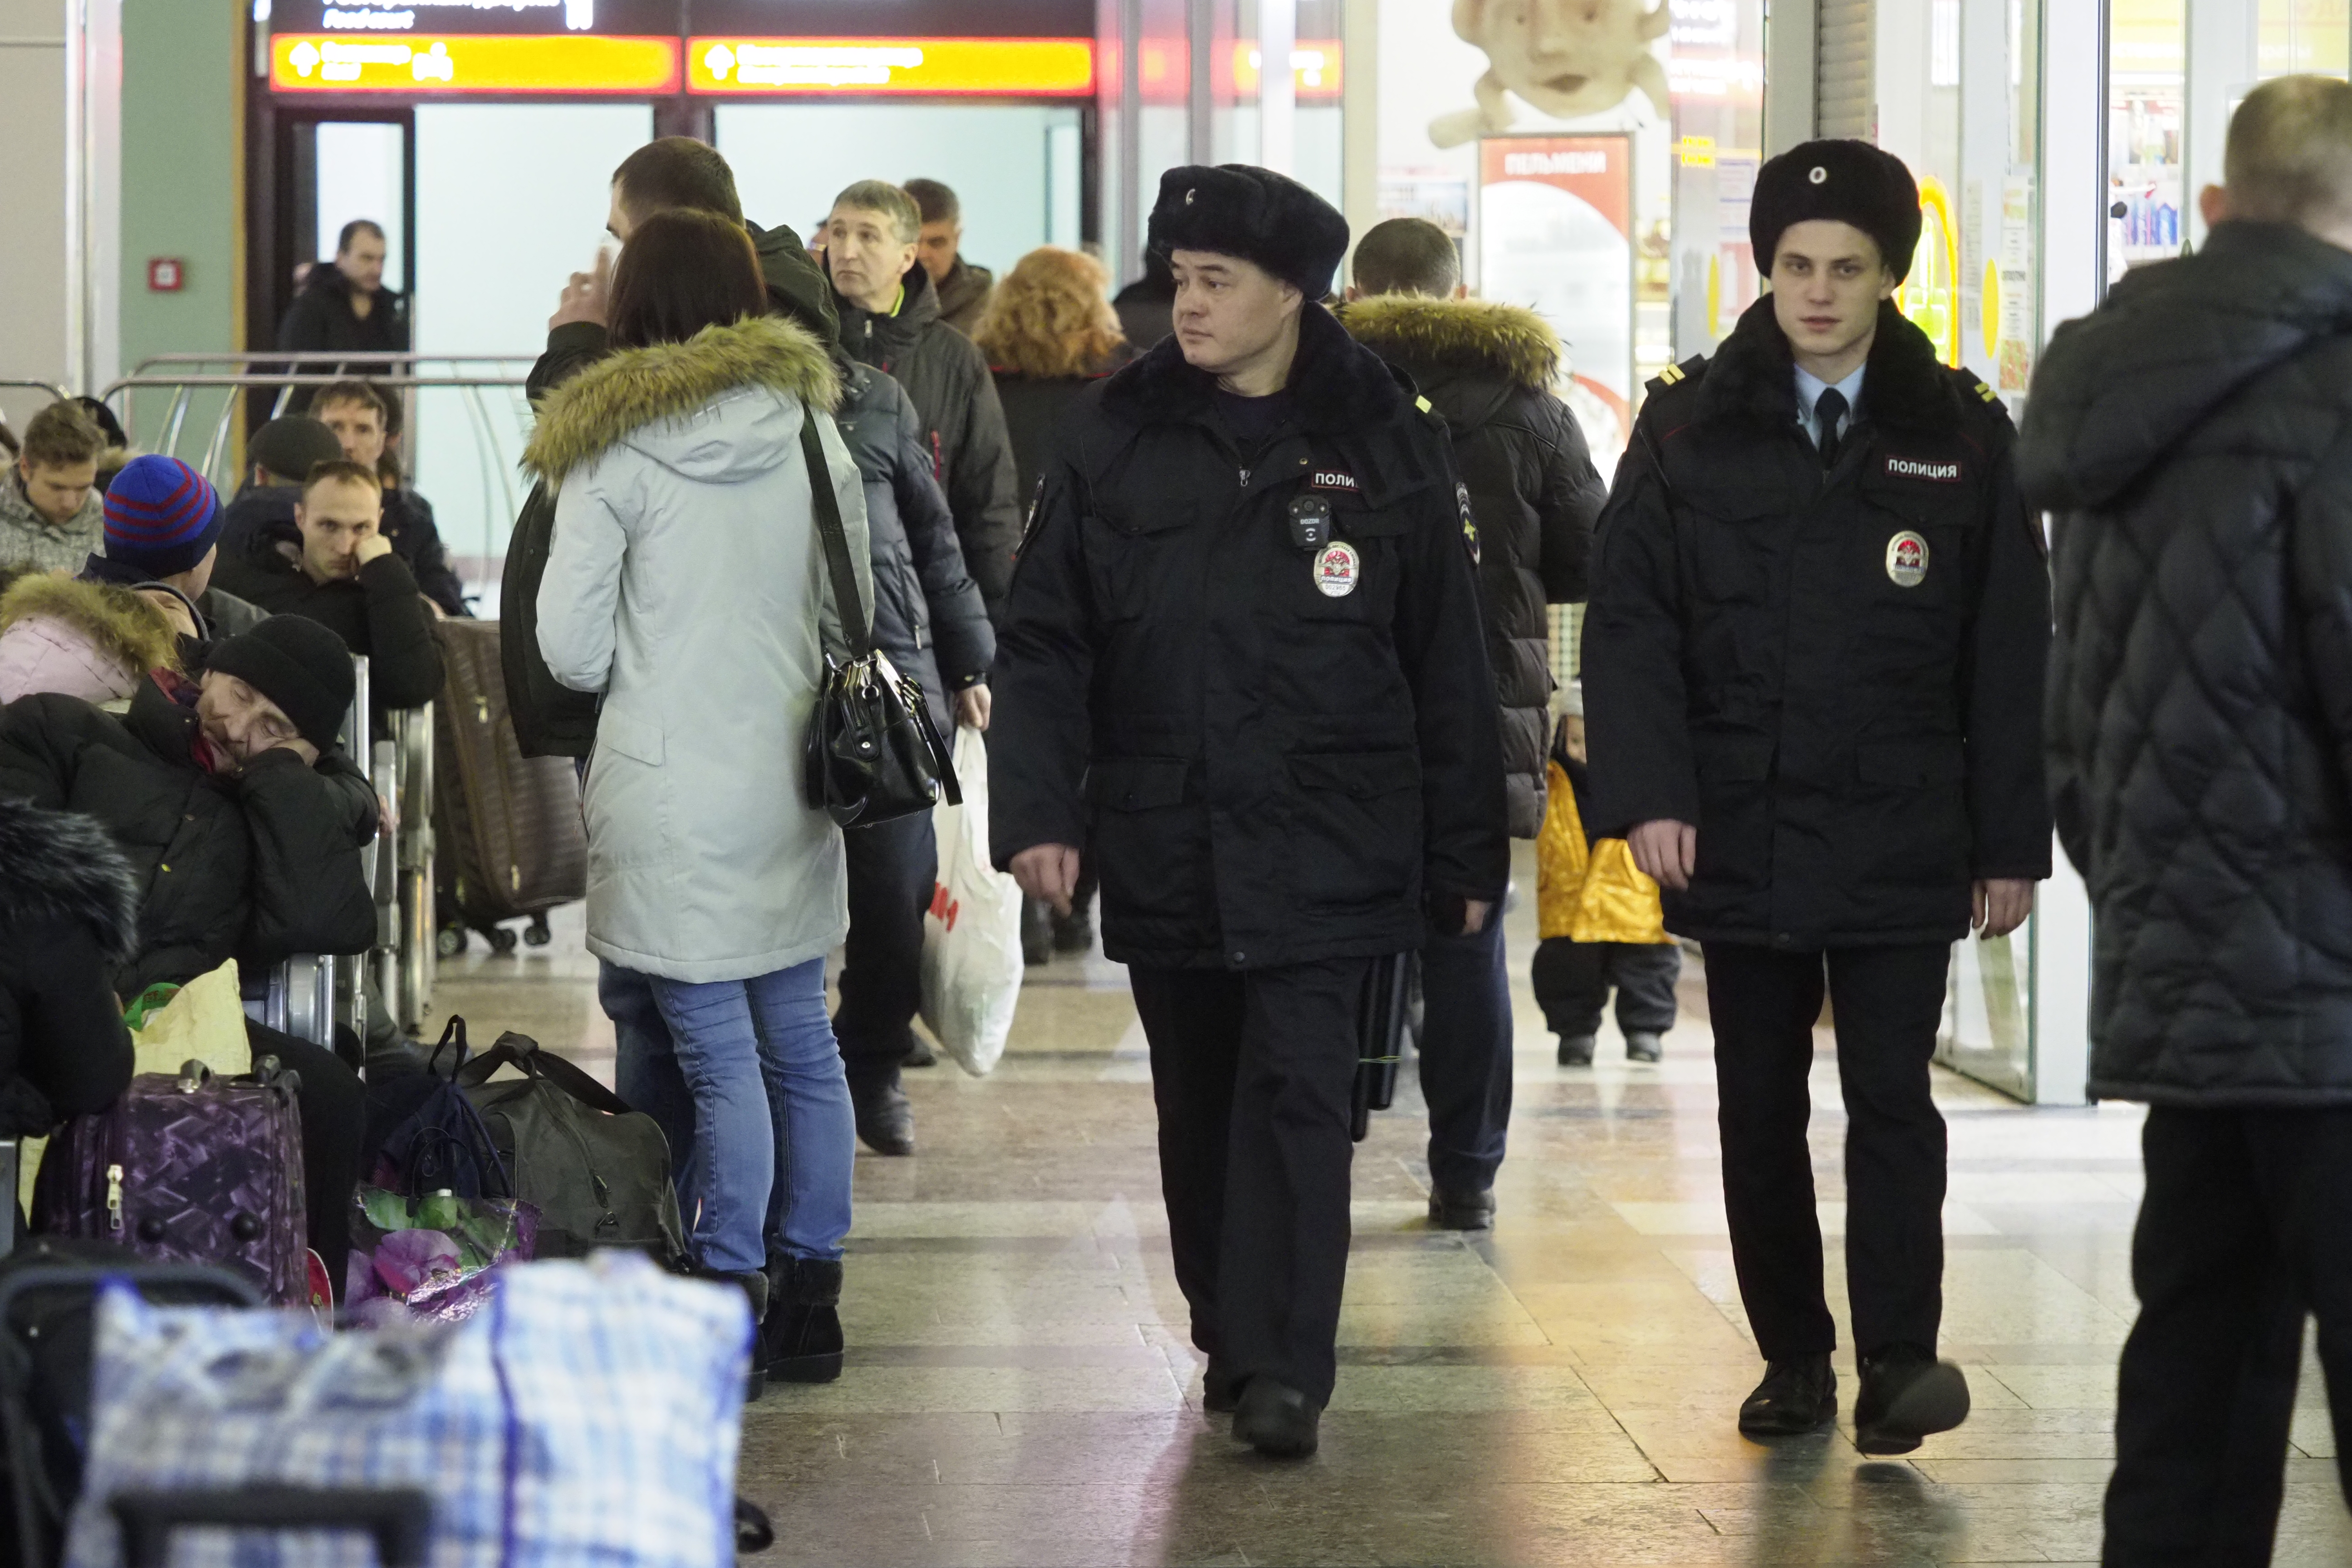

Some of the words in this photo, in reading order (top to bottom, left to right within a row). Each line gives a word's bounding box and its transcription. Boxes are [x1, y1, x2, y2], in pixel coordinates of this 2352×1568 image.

[1504, 151, 1606, 175] ПЕЛЬМЕНИ
[1889, 459, 1956, 479] ПОЛИЦИЯ
[1315, 473, 1358, 489] ПОЛИ
